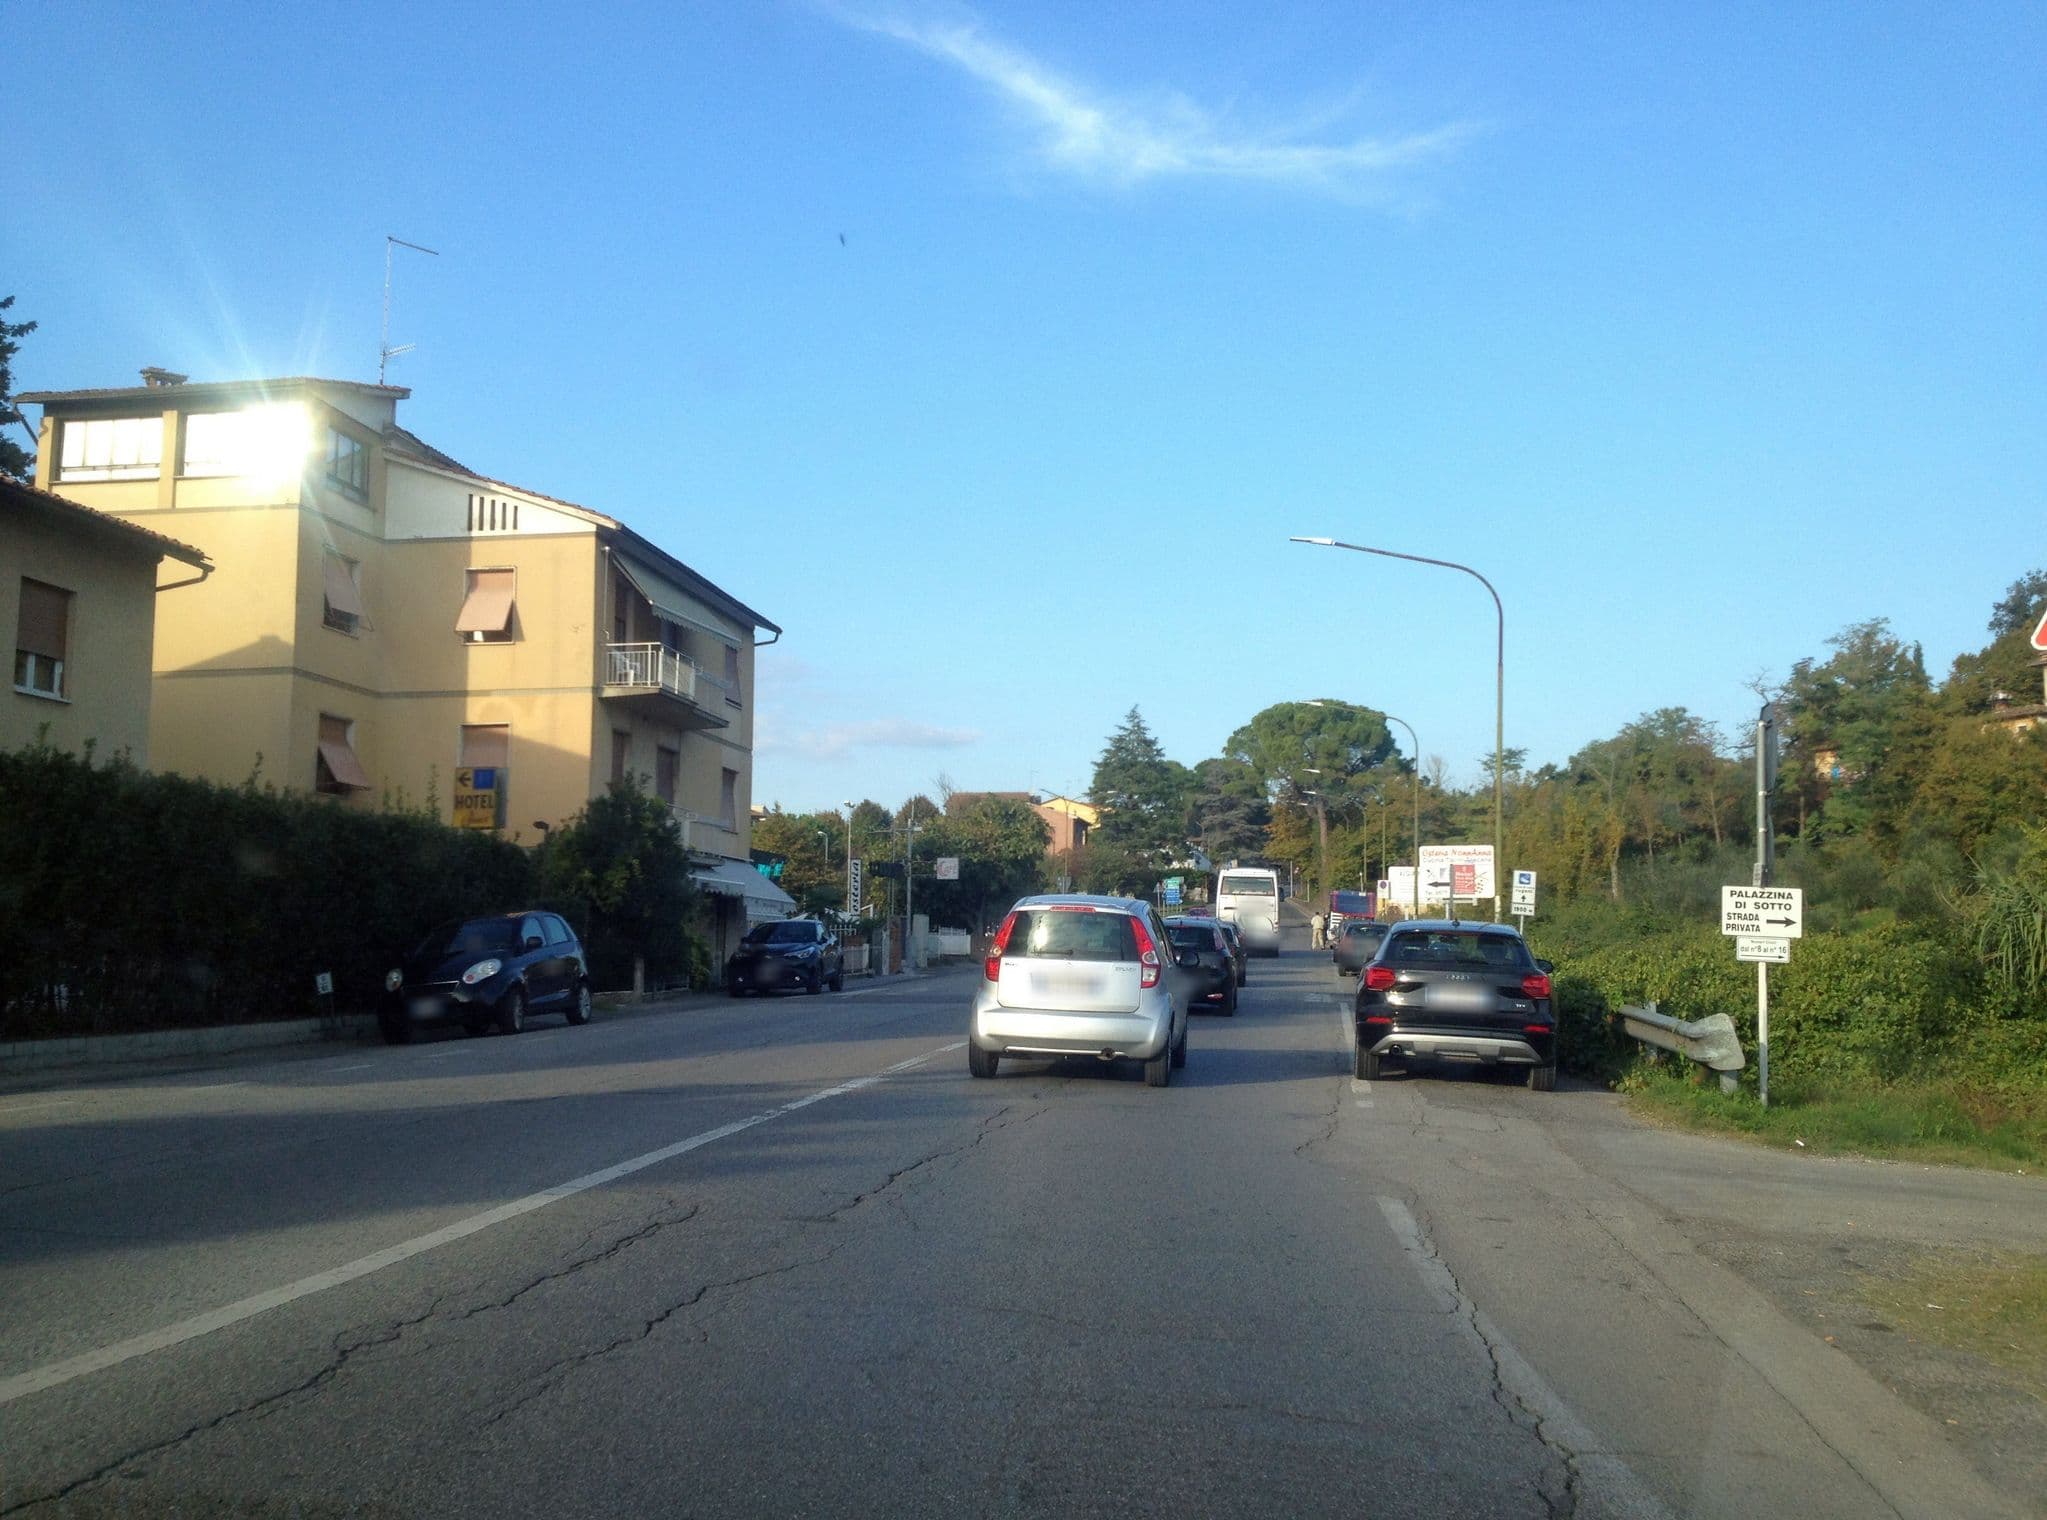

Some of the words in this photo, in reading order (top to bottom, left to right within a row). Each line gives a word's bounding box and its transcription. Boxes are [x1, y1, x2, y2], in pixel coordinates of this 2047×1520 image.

[455, 794, 494, 809] HOTEL
[1730, 890, 1794, 900] PALAZZINA
[1735, 901, 1747, 909] DI
[1754, 902, 1792, 911] SOTTO
[1727, 912, 1760, 921] STRADA
[1726, 923, 1761, 932] PRIVATA
[1779, 946, 1787, 954] 16
